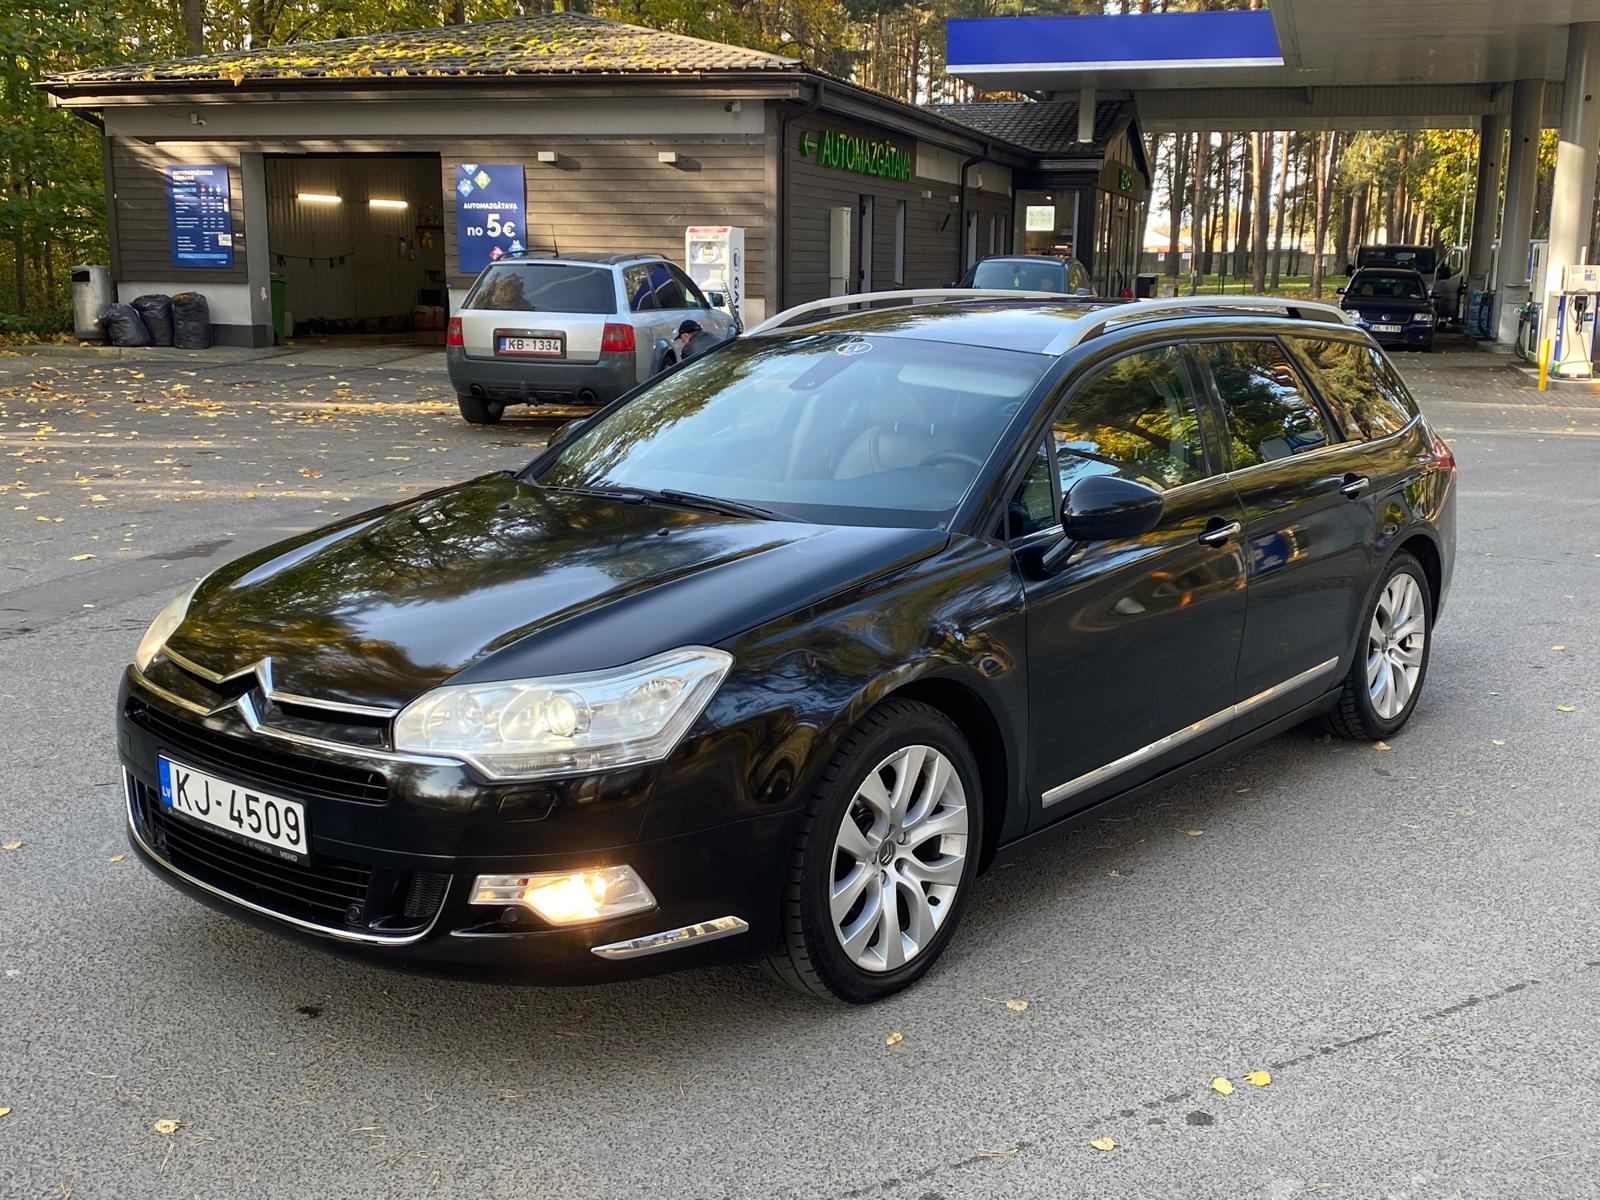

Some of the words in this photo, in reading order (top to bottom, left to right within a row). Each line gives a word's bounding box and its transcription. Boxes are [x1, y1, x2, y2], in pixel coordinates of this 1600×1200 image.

[822, 130, 912, 182] AUTOMAZGĀTAVA
[463, 201, 518, 210] AUTOMAZGĀTAVA
[467, 226, 483, 237] no
[487, 213, 516, 237] 5€
[508, 340, 559, 351] KB-1334
[162, 786, 171, 798] LV
[176, 769, 301, 845] KJ-4509
